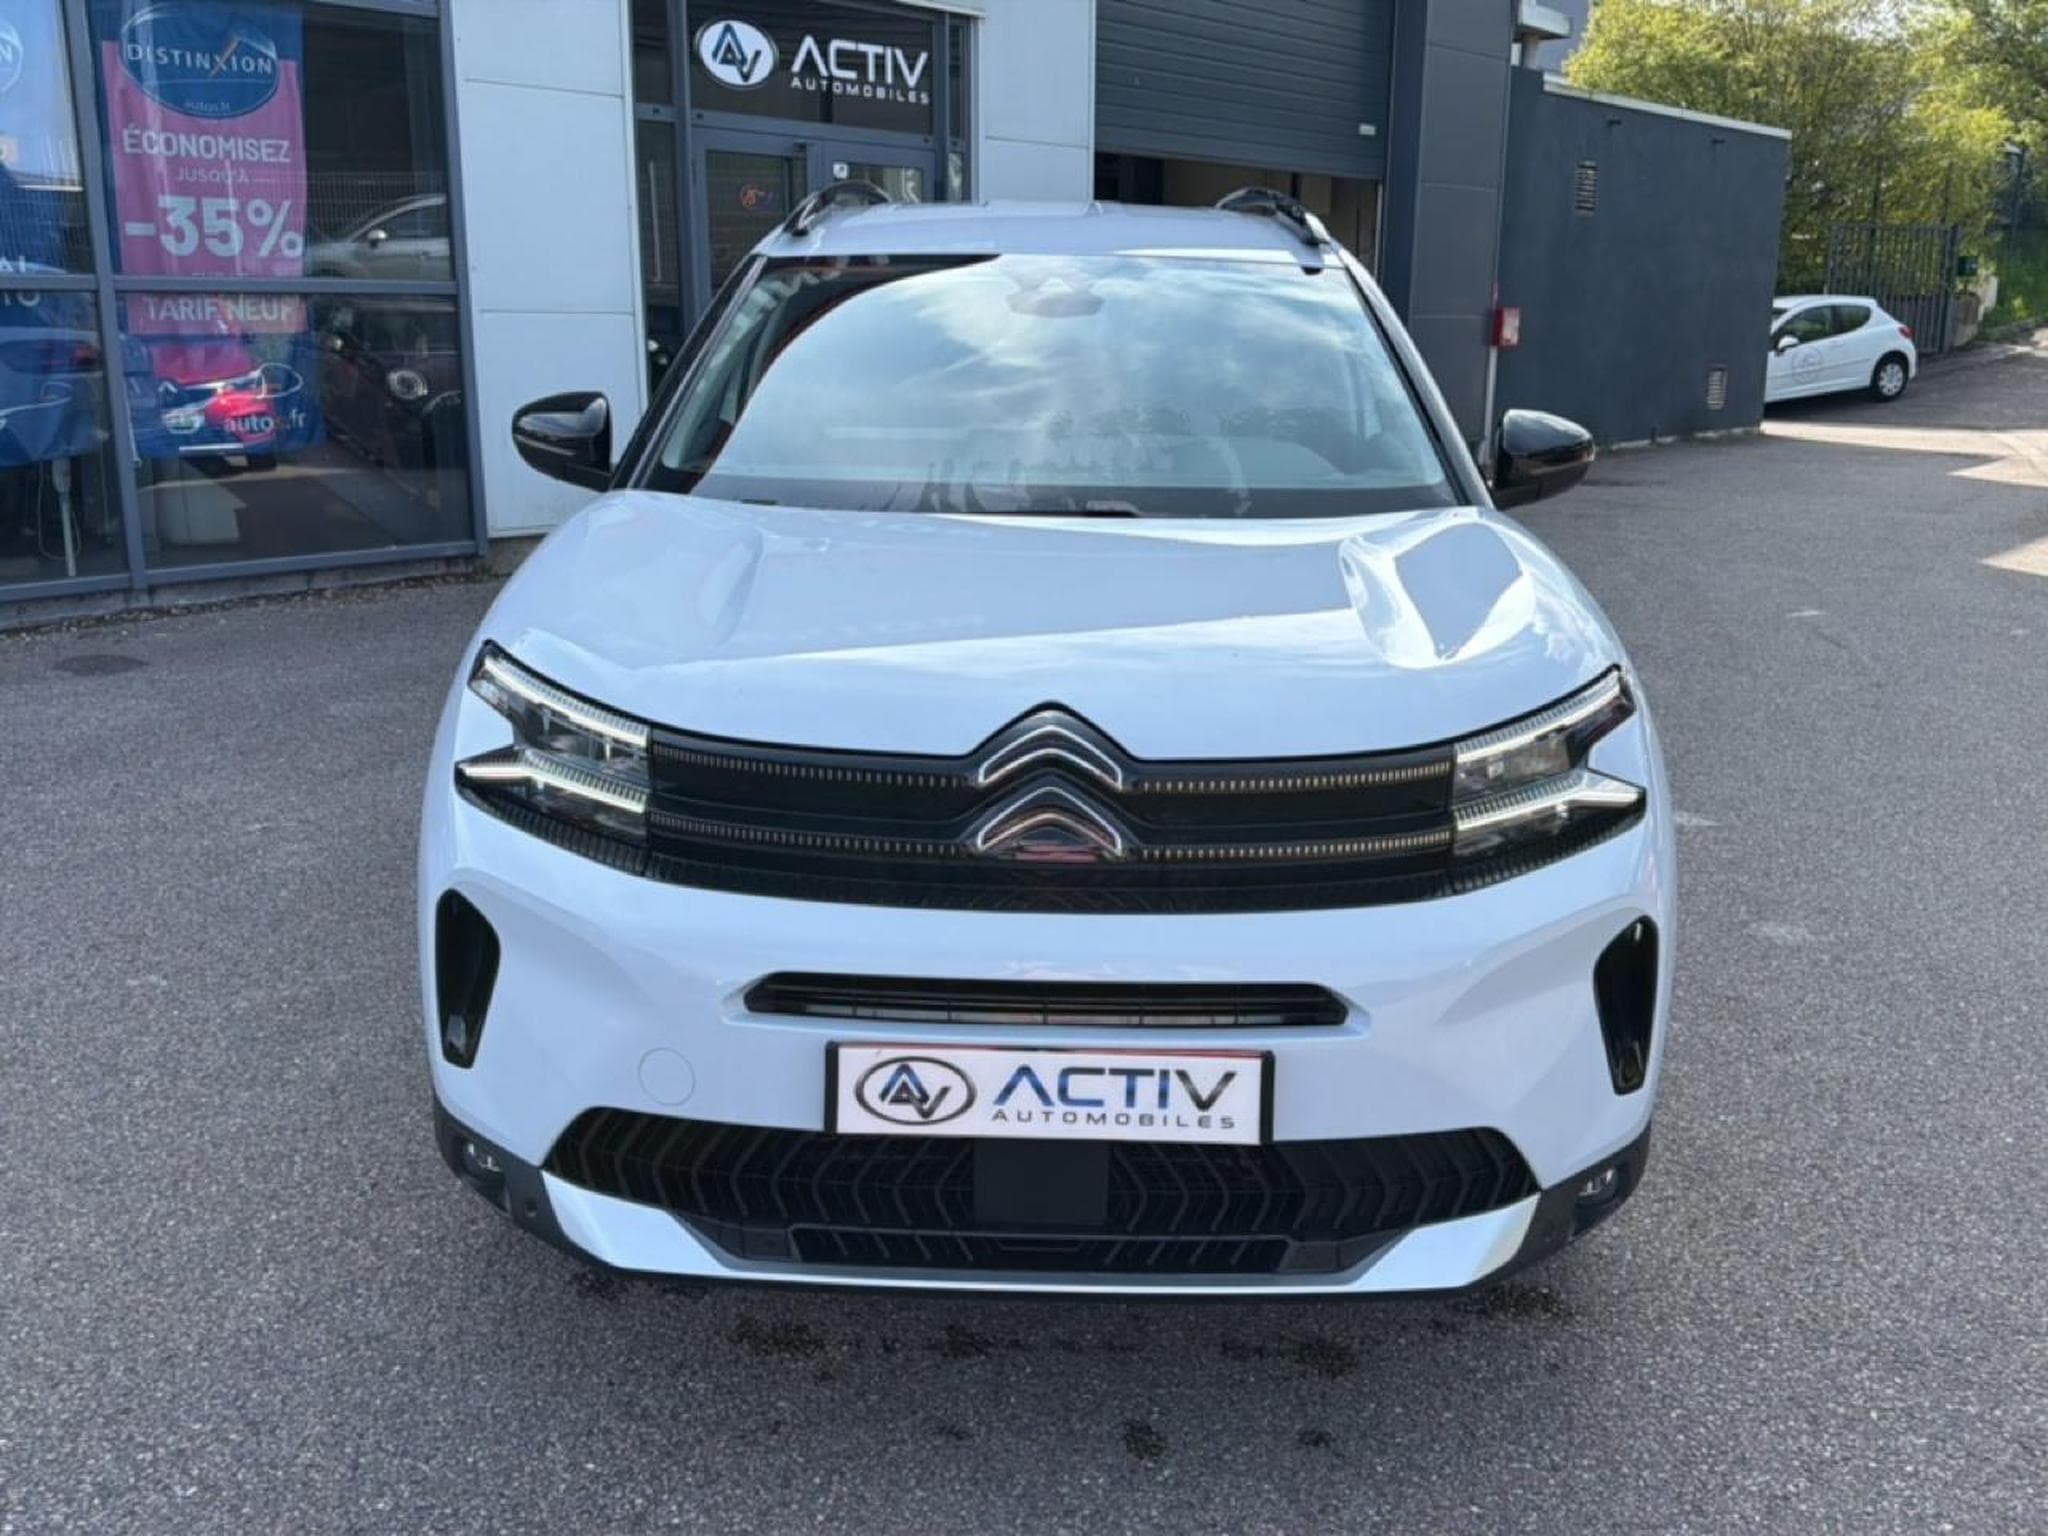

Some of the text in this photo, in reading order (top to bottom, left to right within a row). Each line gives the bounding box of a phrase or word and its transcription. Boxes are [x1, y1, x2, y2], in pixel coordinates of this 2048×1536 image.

[127, 41, 272, 75] DISTINXION
[792, 35, 928, 88] ACTIV
[791, 78, 930, 104] AUTOMOBILES
[122, 124, 291, 163] ÉCONOMISEZ
[125, 194, 303, 258] -35%
[143, 293, 301, 321] TARIF NEUF
[993, 1065, 1237, 1112] ACTIV
[991, 1110, 1236, 1130] AUTOMOBILES
